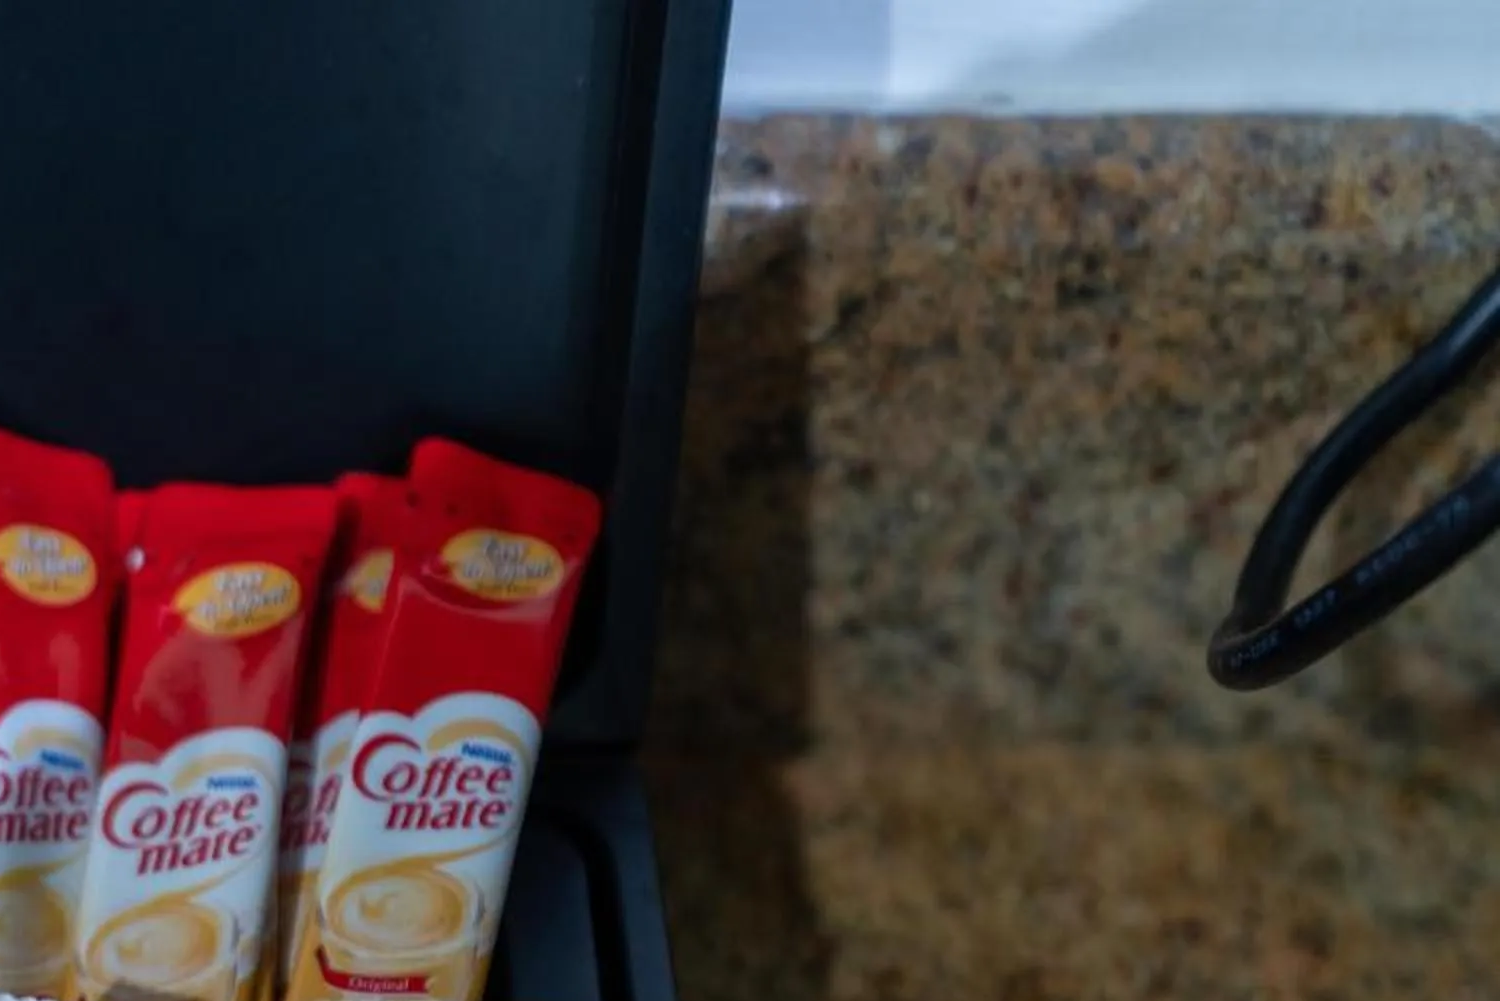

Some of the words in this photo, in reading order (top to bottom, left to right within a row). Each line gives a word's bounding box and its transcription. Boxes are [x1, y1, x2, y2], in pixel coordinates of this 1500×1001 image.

[352, 734, 513, 801] Coffee
[102, 780, 260, 850] Coffee
[384, 797, 508, 831] mate
[136, 825, 258, 876] mate
